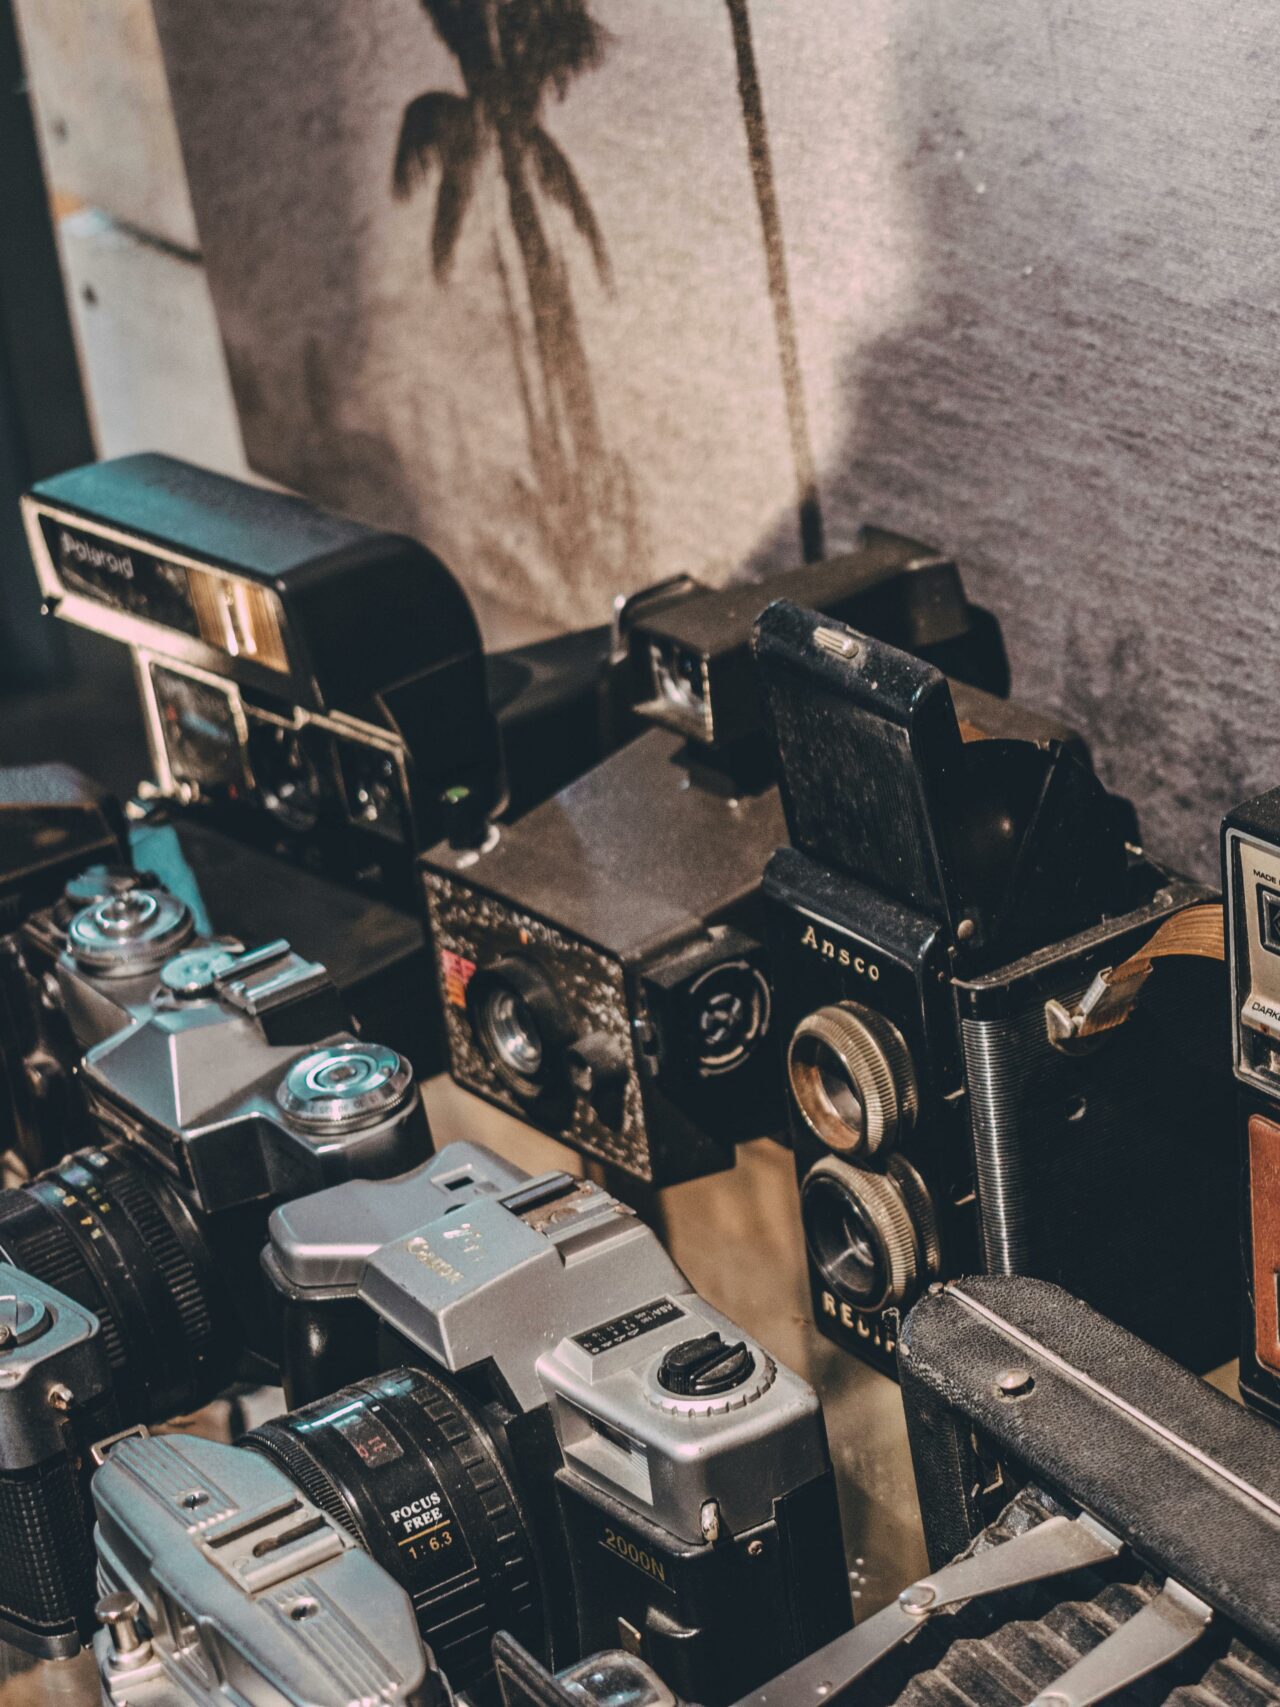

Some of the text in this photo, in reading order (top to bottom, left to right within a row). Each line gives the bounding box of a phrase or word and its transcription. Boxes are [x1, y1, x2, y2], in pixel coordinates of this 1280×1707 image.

[61, 531, 135, 579] Polaroid
[1253, 869, 1277, 884] MADE
[801, 925, 880, 982] Ansco
[390, 1491, 442, 1524] FOCUS
[403, 1507, 443, 1534] FREE
[604, 1527, 665, 1582] 2000N
